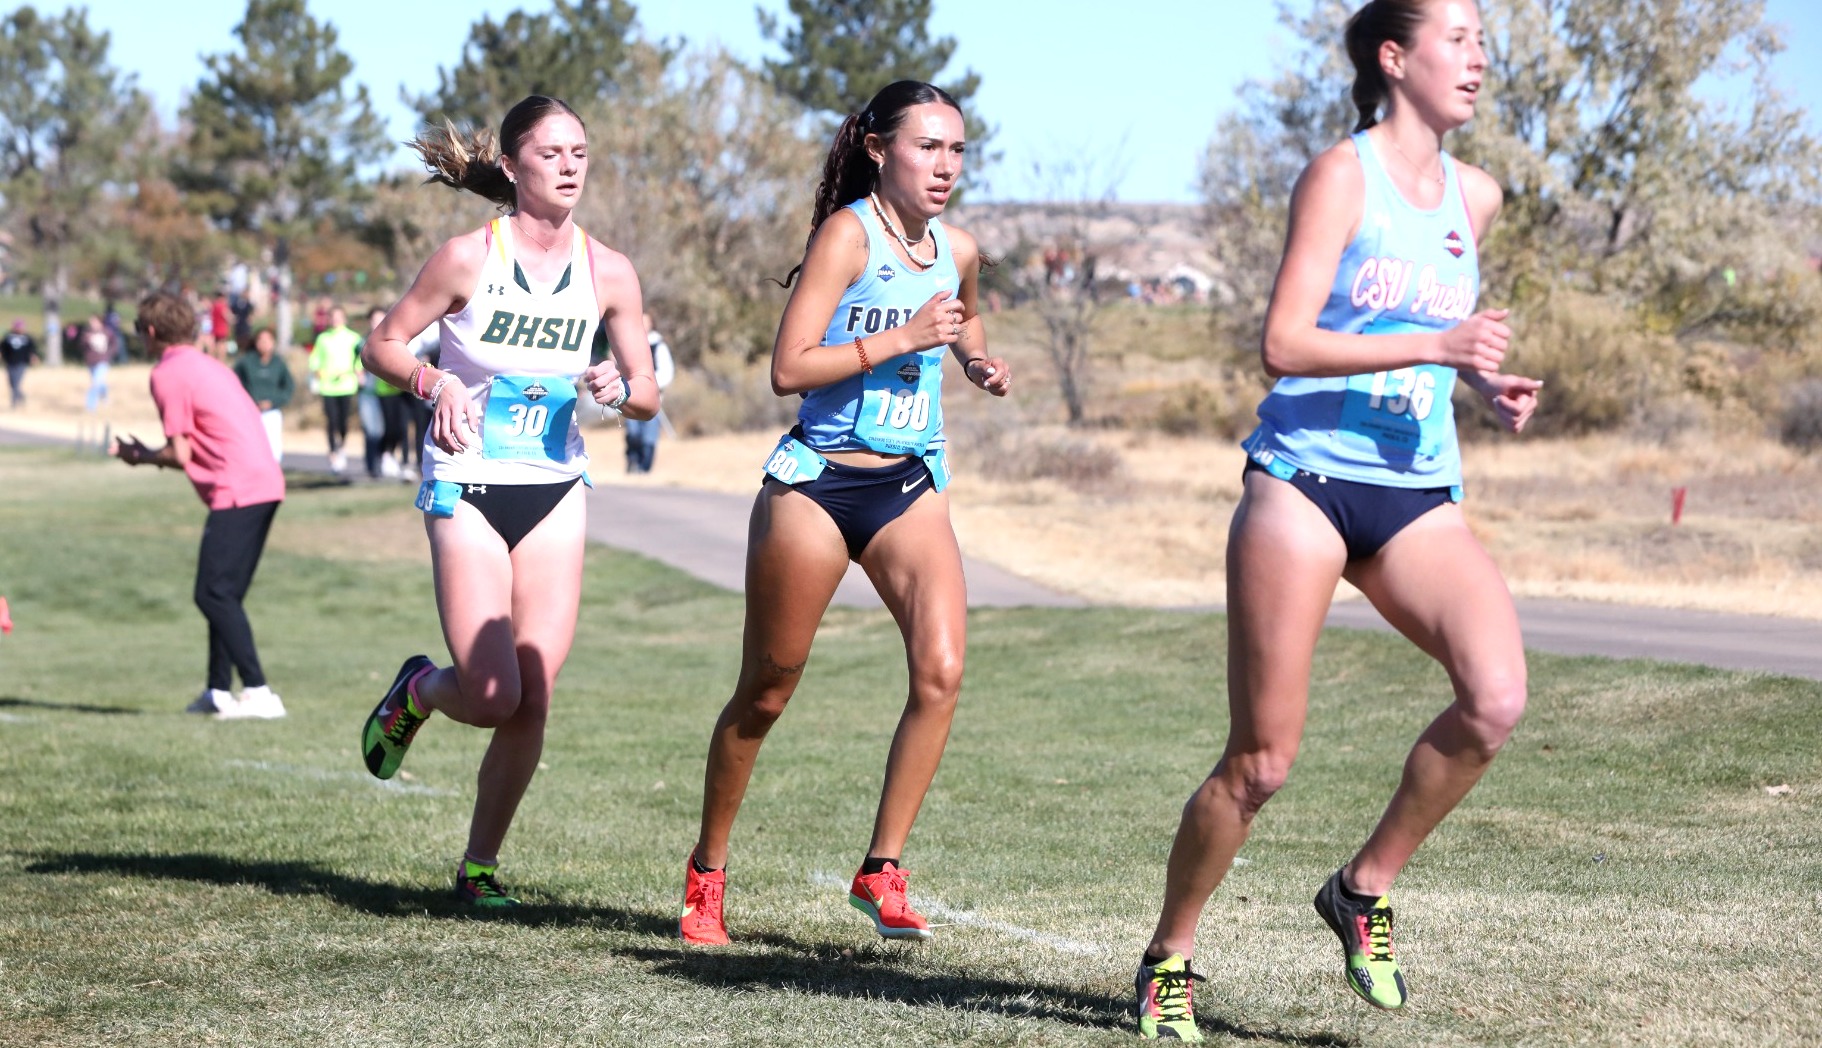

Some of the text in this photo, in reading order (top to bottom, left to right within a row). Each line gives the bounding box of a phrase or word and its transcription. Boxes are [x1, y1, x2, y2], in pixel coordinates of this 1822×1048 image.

[1351, 256, 1414, 311] CSU
[479, 309, 587, 352] BHSU
[876, 387, 931, 432] 180
[1369, 367, 1435, 421] 136
[504, 403, 548, 437] 30
[418, 486, 435, 512] 30
